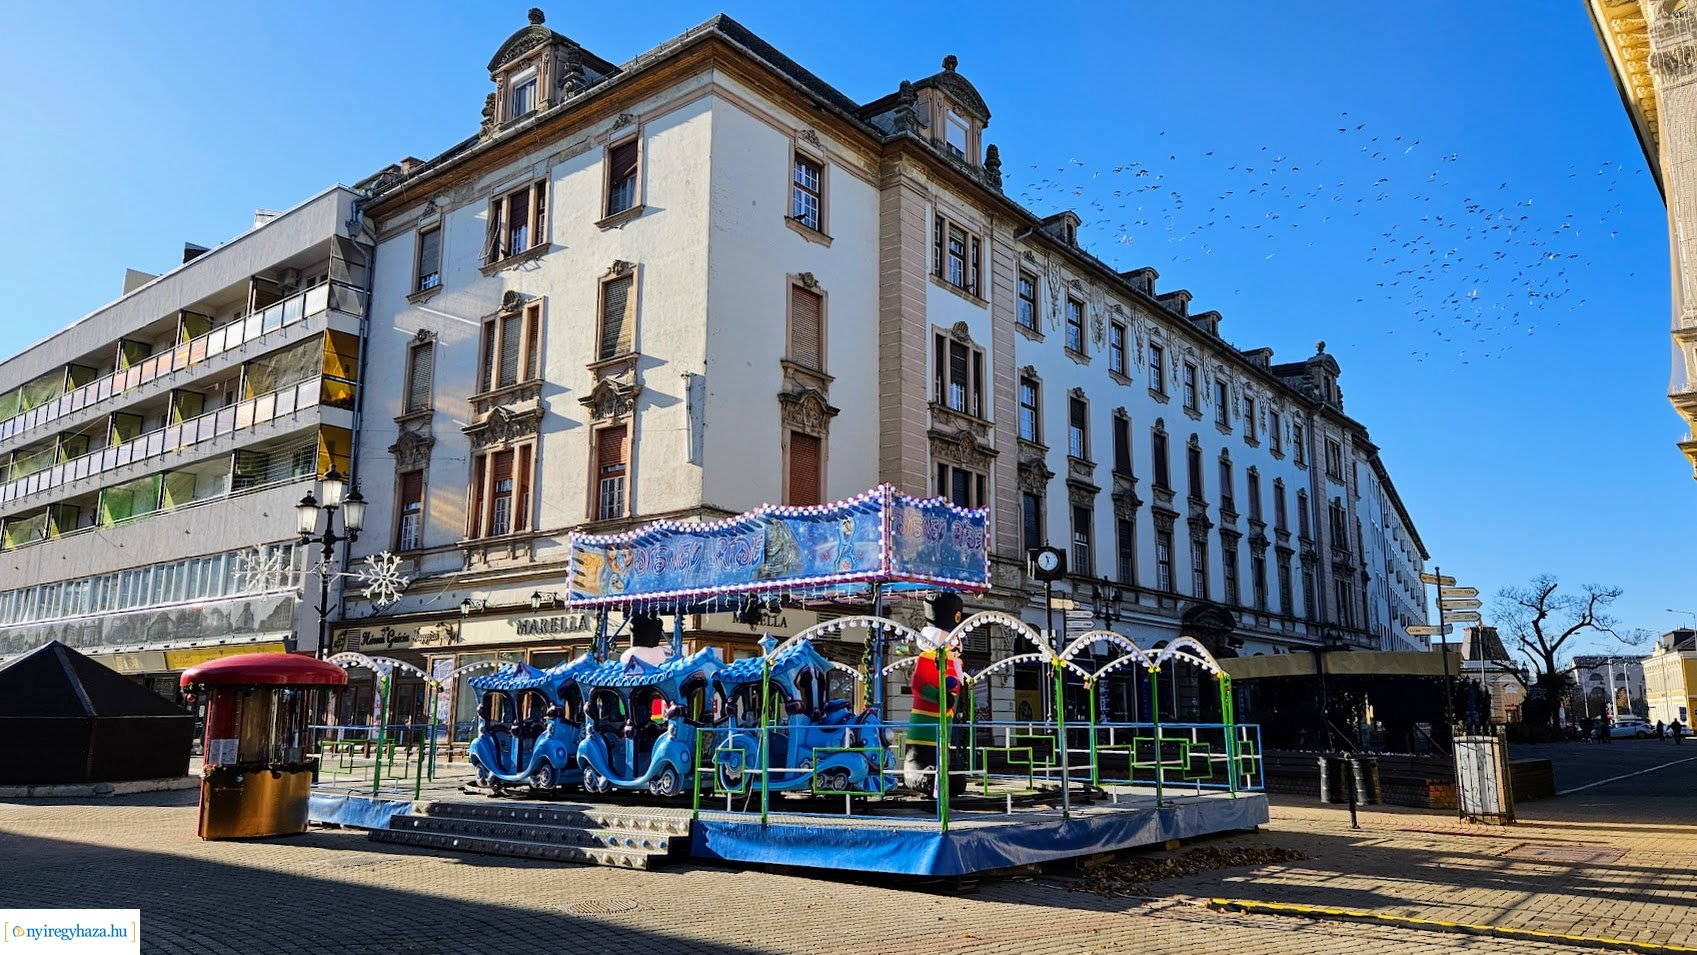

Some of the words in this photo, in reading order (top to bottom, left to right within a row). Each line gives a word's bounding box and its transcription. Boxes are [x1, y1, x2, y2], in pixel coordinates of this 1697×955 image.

[715, 534, 765, 571] RIDE
[516, 615, 588, 634] MARELLA
[732, 612, 788, 628] MELLA
